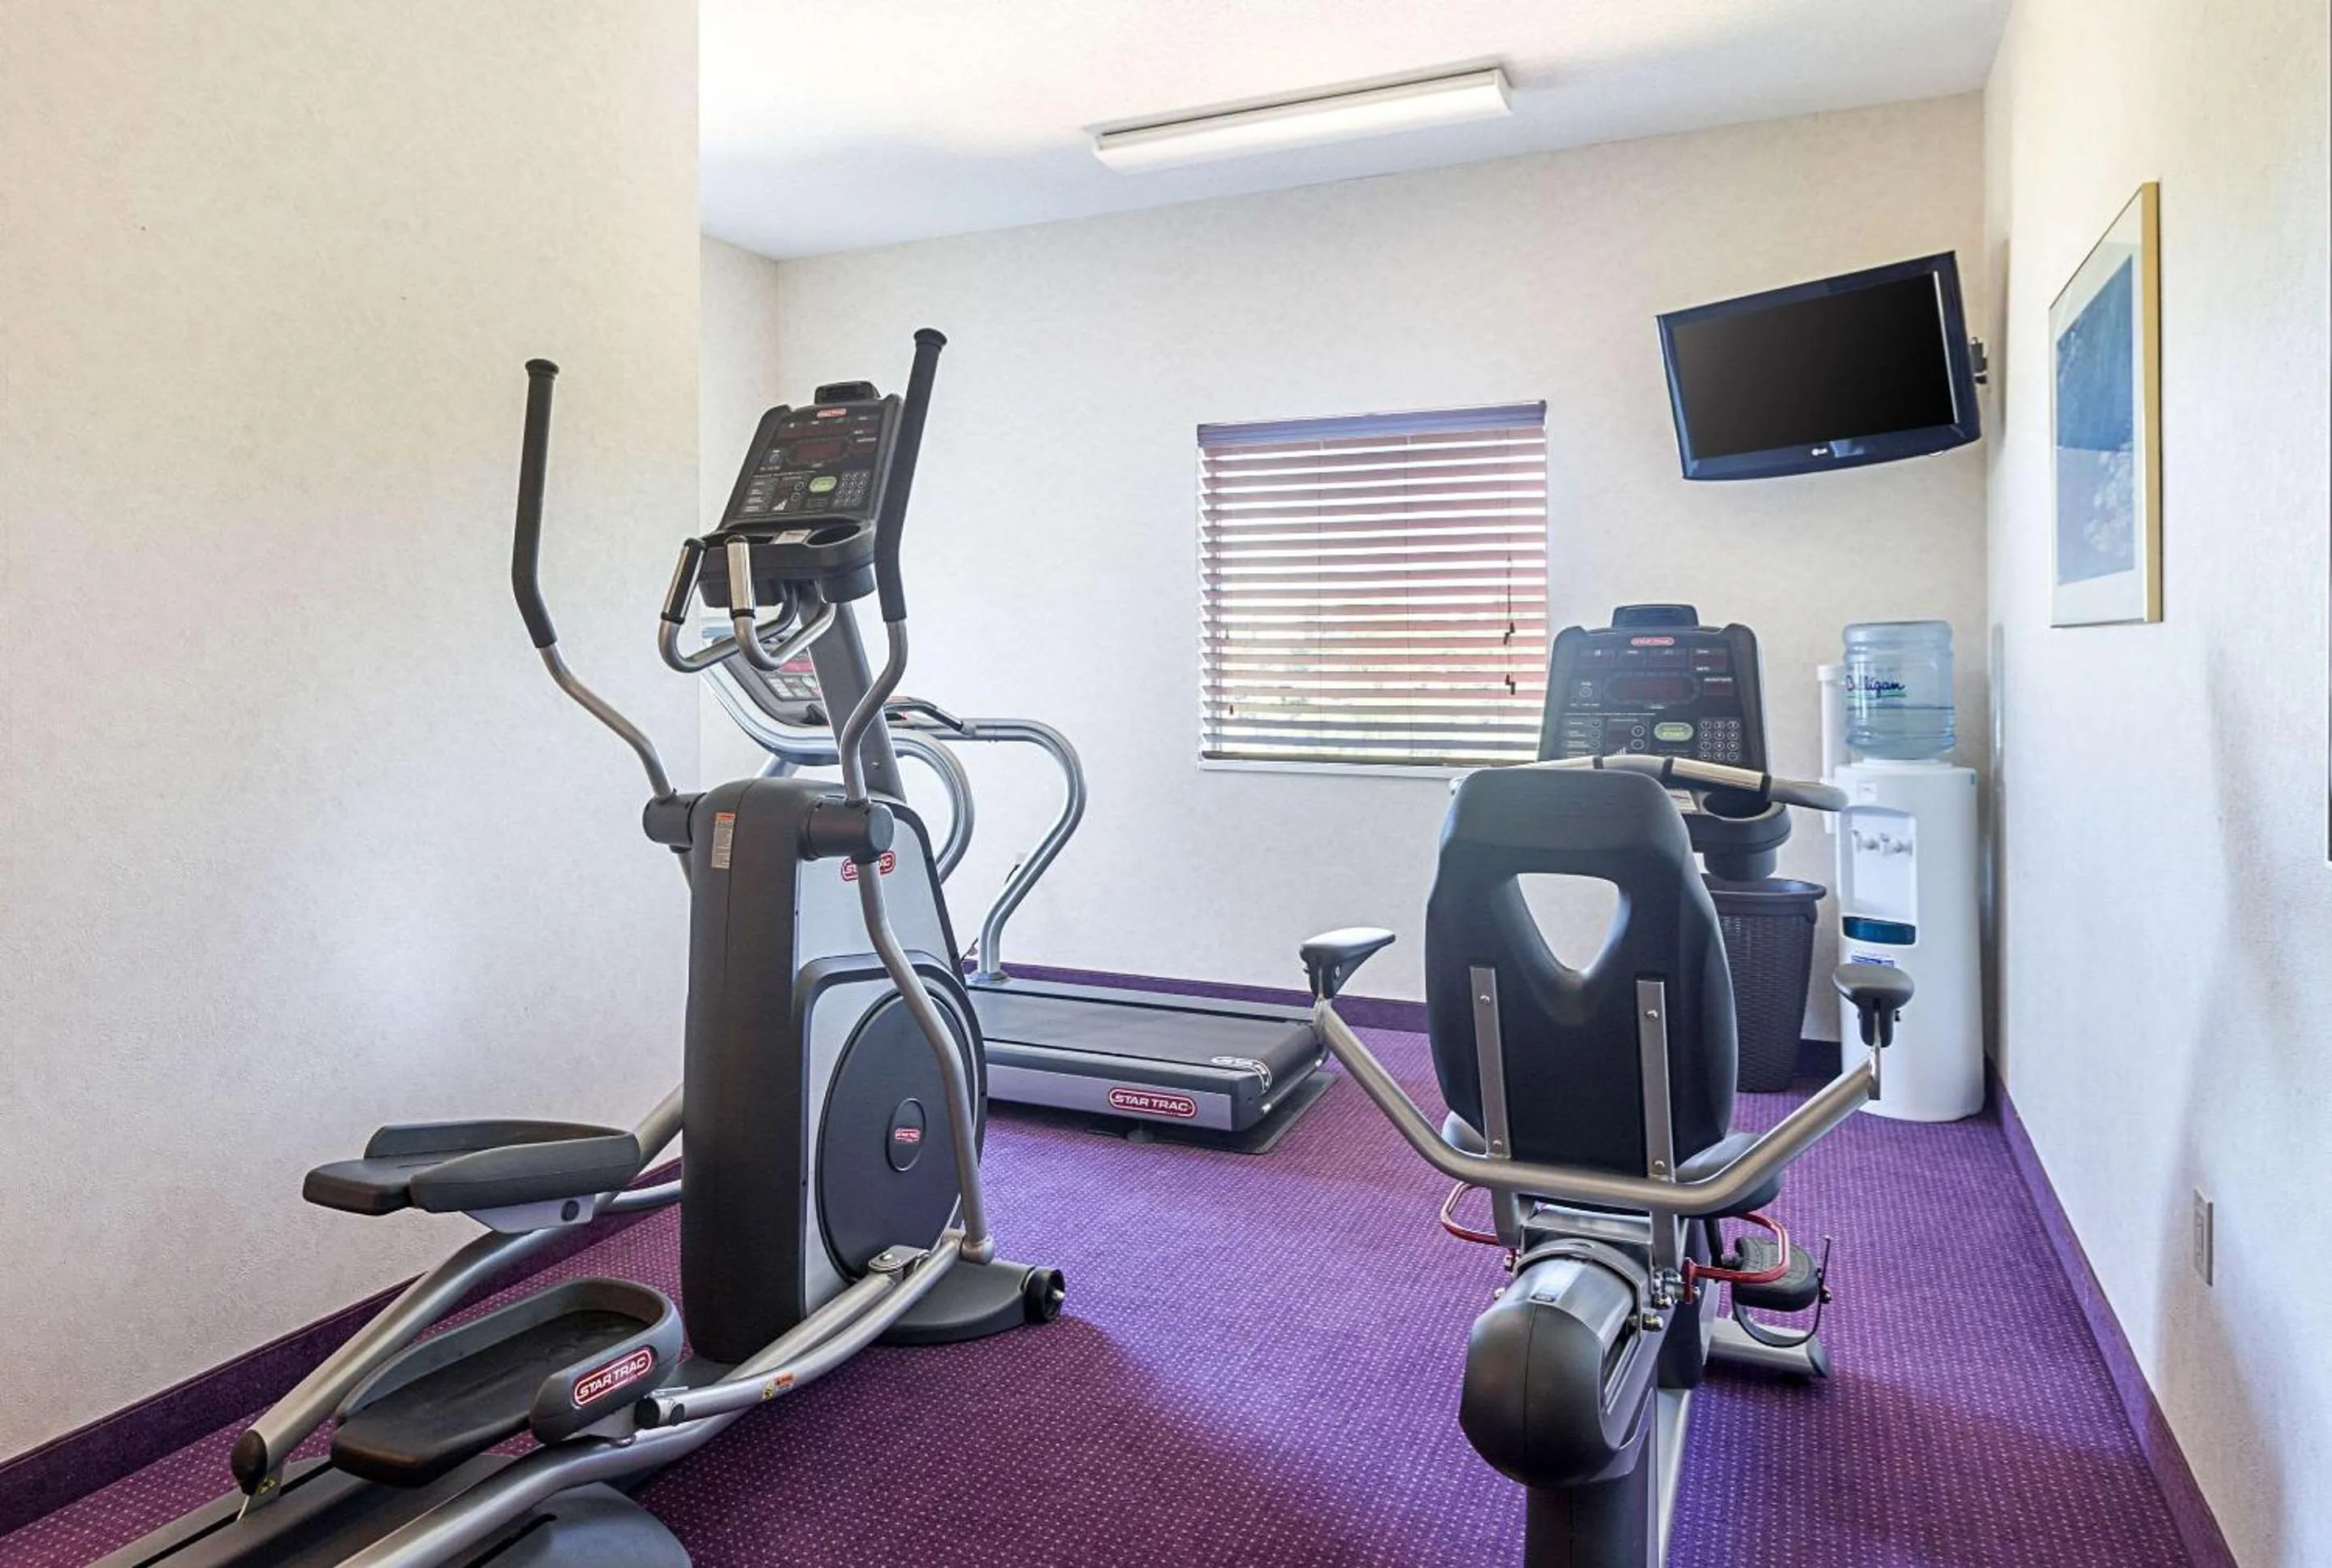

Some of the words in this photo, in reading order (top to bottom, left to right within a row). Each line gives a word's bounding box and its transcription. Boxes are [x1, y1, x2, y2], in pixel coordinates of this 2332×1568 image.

[1115, 1094, 1149, 1107] STAR
[1151, 1098, 1189, 1111] TRAC
[579, 1375, 611, 1397] STAR
[612, 1356, 646, 1380] TRAC
